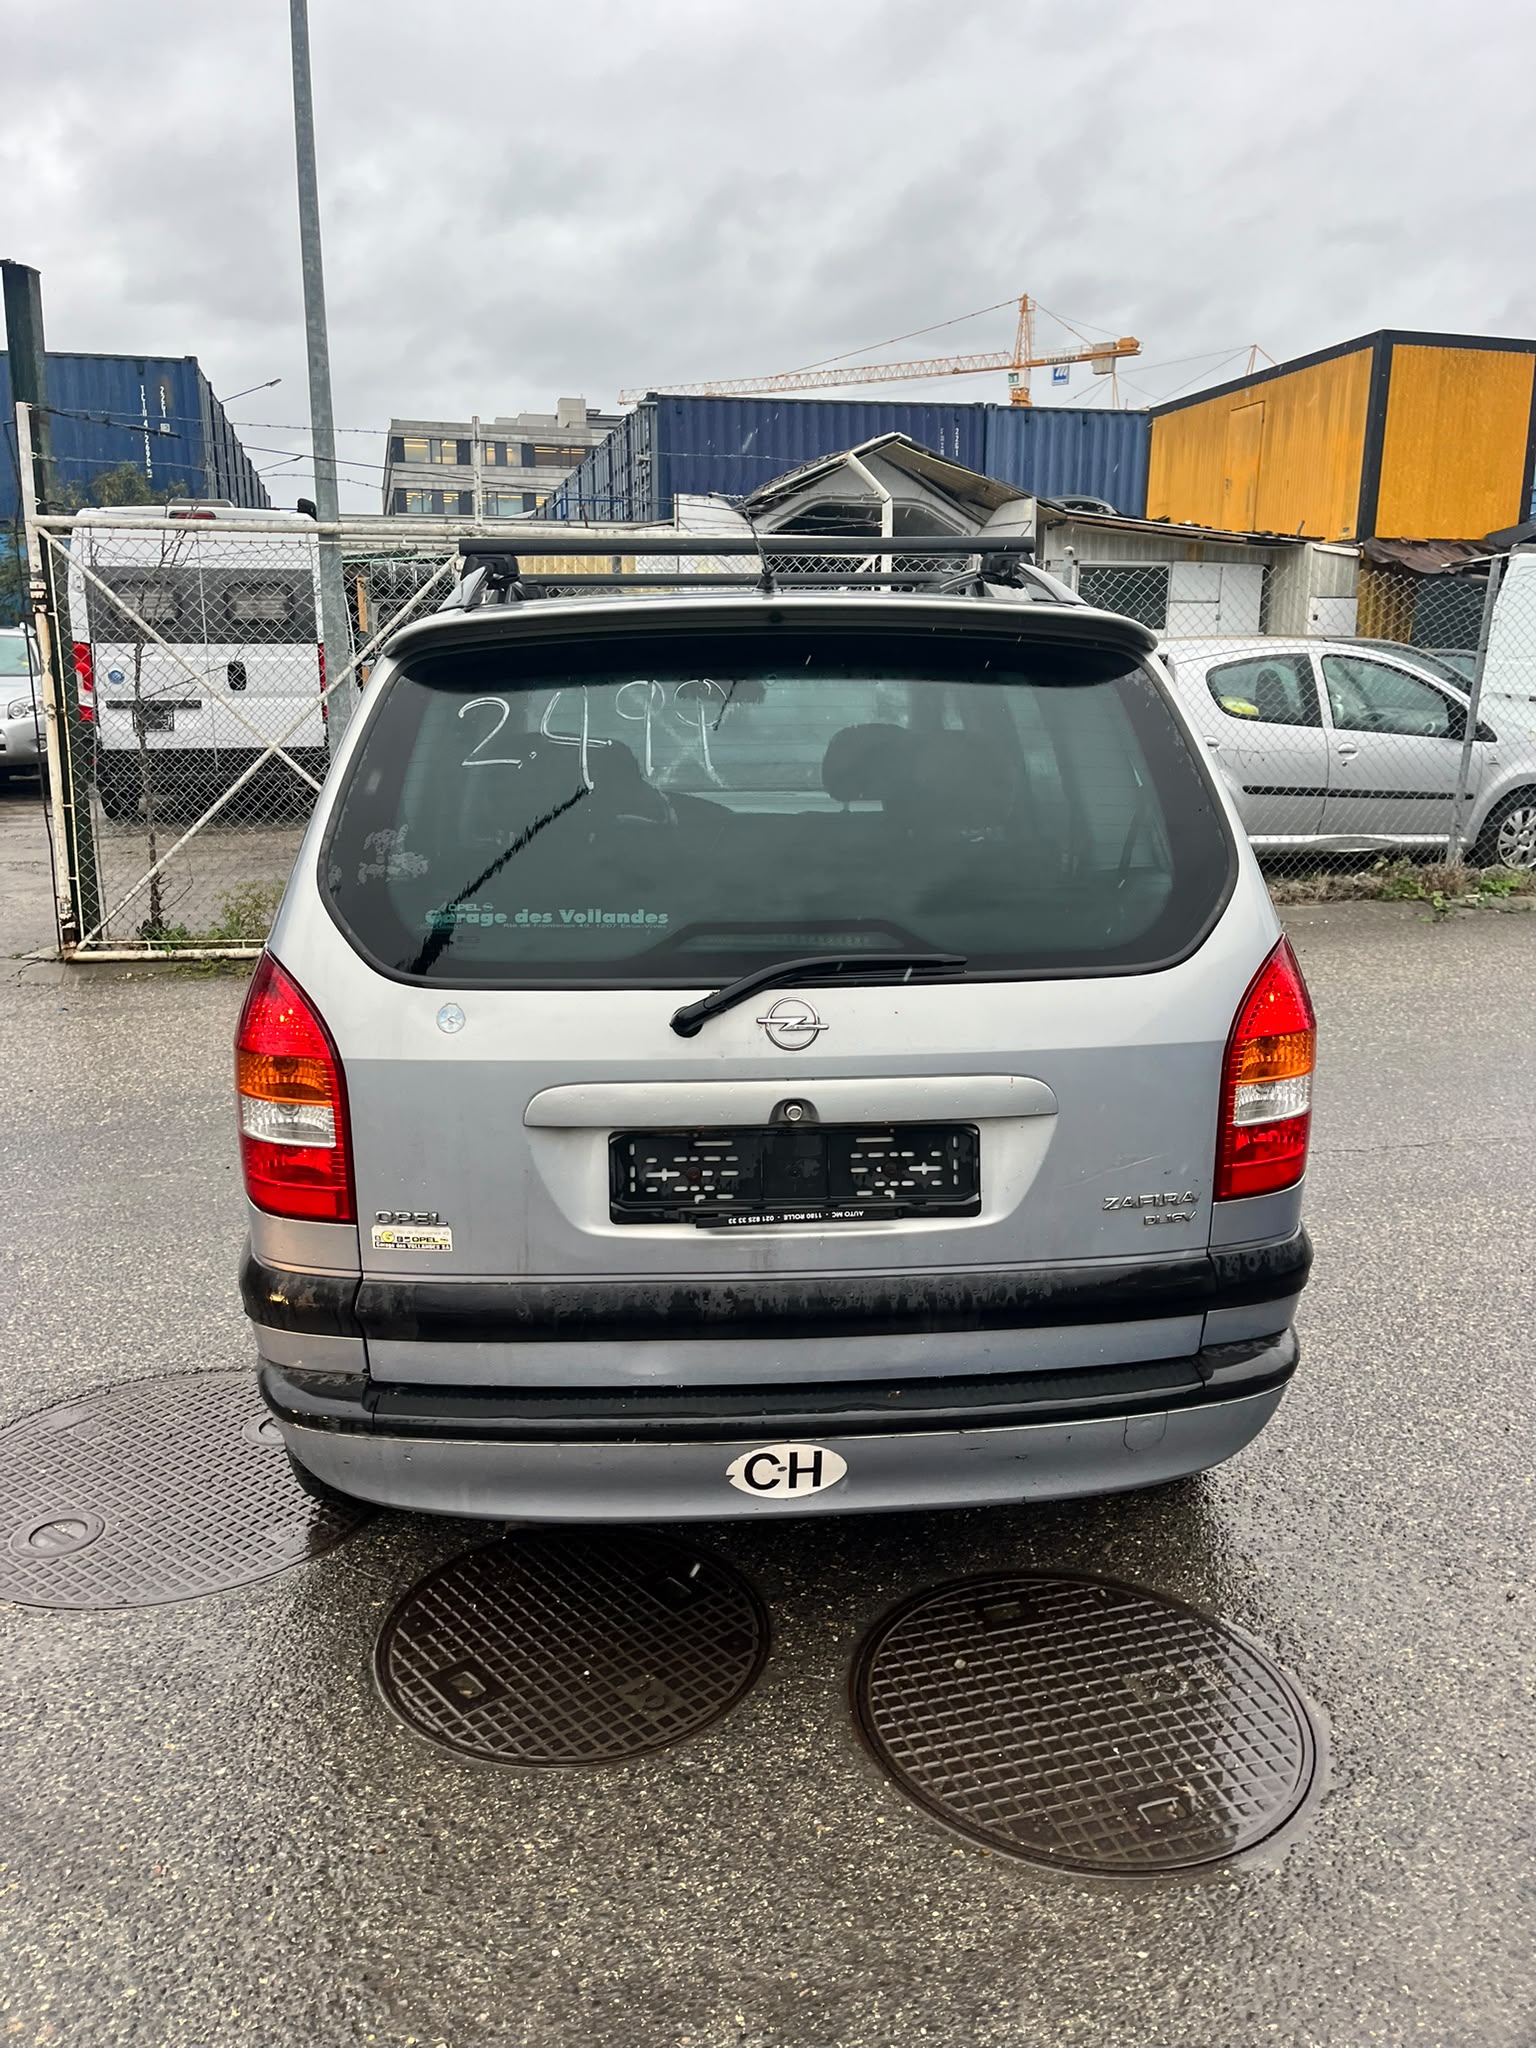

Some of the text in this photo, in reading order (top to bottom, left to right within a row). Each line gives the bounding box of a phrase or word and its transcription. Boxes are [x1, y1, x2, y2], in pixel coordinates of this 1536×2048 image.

[448, 903, 481, 911] OPEL
[425, 908, 669, 927] Garage des Vollandes
[1103, 1191, 1199, 1210] ZAFIRA
[375, 1210, 449, 1226] OPEL
[783, 1213, 805, 1221] ROLLE
[743, 1449, 823, 1491] CH
